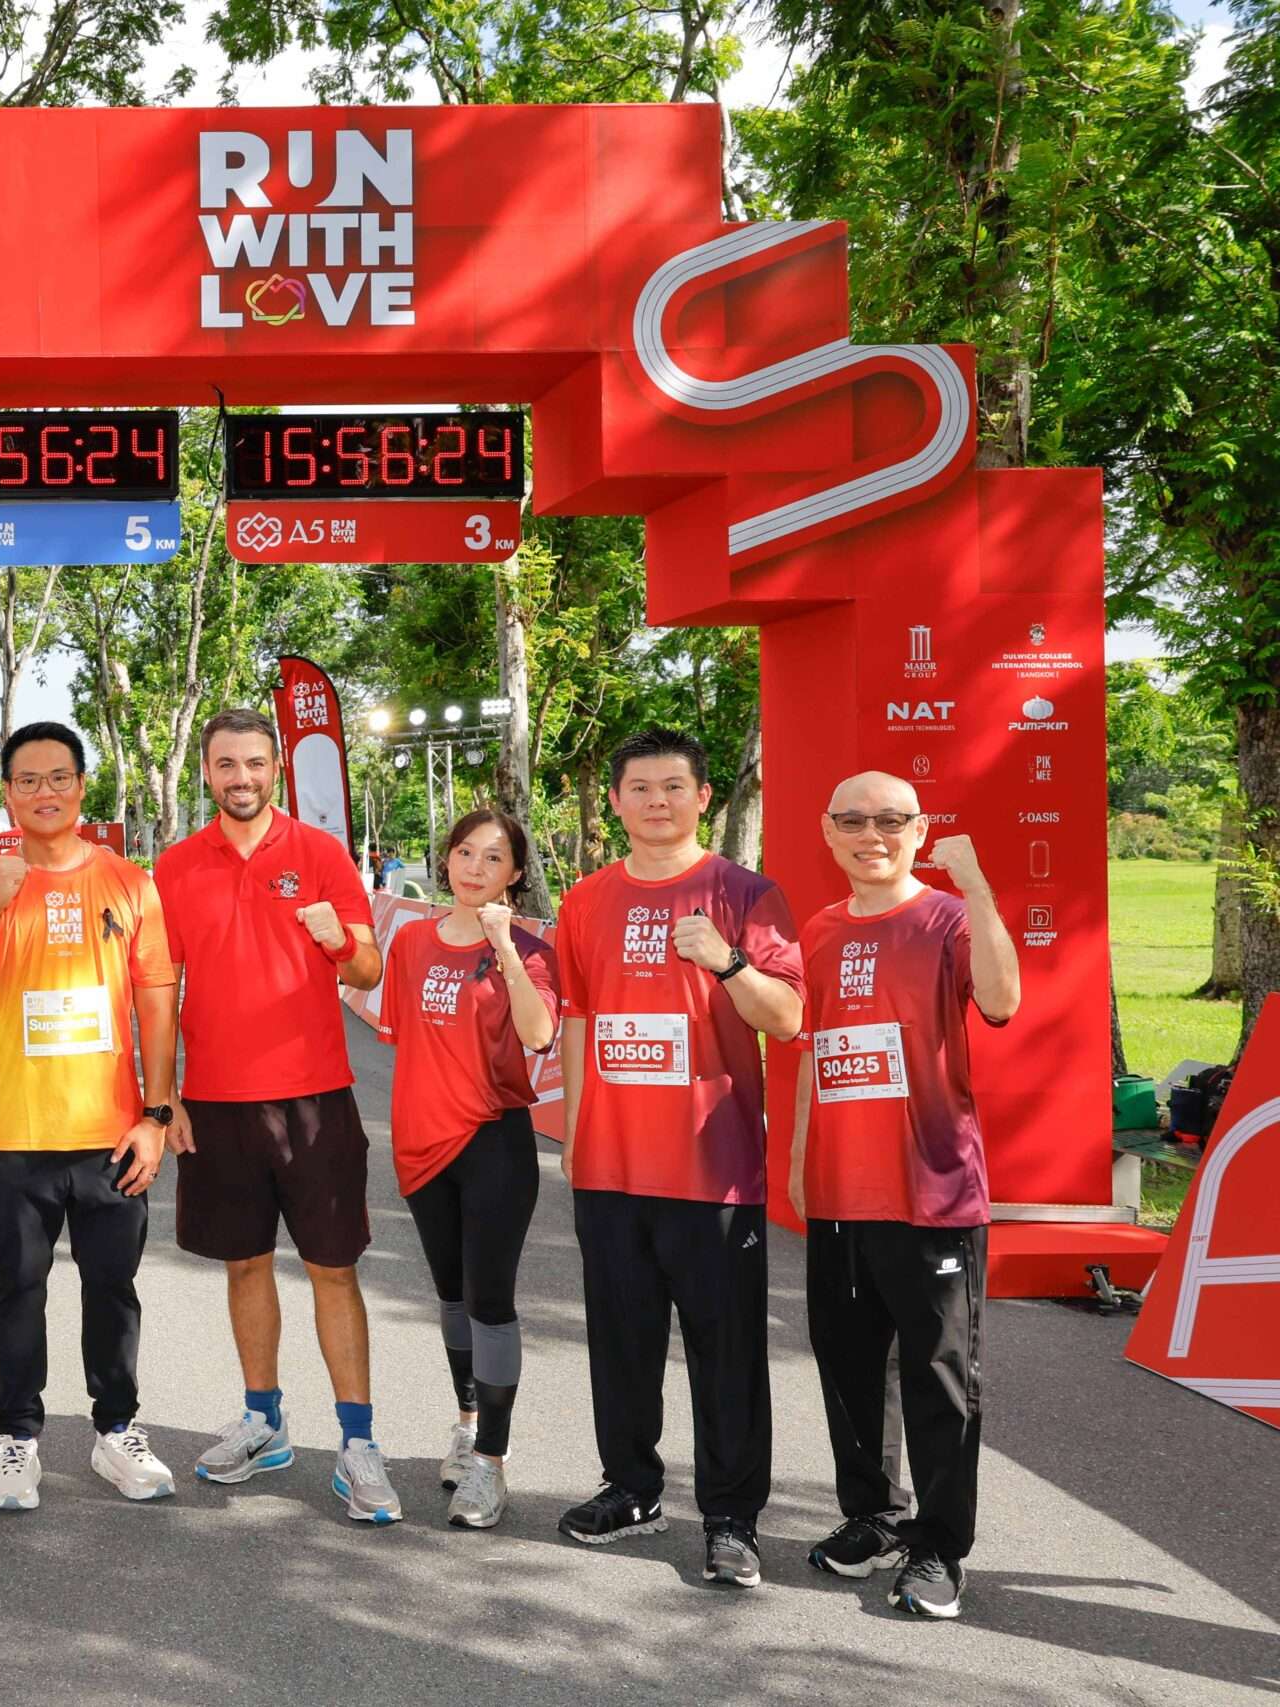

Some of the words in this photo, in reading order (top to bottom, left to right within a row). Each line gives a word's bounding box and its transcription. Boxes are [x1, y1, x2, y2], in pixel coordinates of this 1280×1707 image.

[199, 129, 413, 208] RUN
[198, 213, 413, 268] WITH
[200, 273, 415, 328] LOVE
[263, 426, 512, 485] 15:56:24
[288, 519, 325, 544] A5
[330, 519, 356, 529] RUN
[464, 514, 492, 550] 3
[495, 540, 515, 550] KM
[125, 516, 152, 550] 5
[155, 540, 176, 550] KM
[904, 662, 937, 670] MAJOR
[294, 694, 326, 711] RUN
[887, 701, 956, 720] NAT
[296, 707, 327, 719] WITH
[1036, 755, 1052, 769] PIK
[46, 908, 82, 923] RUN
[651, 908, 670, 920] A5
[48, 923, 82, 933] WITH
[624, 924, 668, 940] RUN
[624, 940, 666, 952] WITH
[863, 942, 879, 954] A5
[623, 952, 665, 964] LOVE
[840, 957, 876, 976] RUN
[423, 978, 461, 994] RUN
[840, 974, 874, 987] WITH
[422, 990, 457, 1004] WITH
[840, 985, 873, 998] LOVE
[624, 1021, 636, 1038] 3
[838, 1035, 850, 1052] 3
[604, 1043, 665, 1061] 30506
[822, 1056, 880, 1078] 30425
